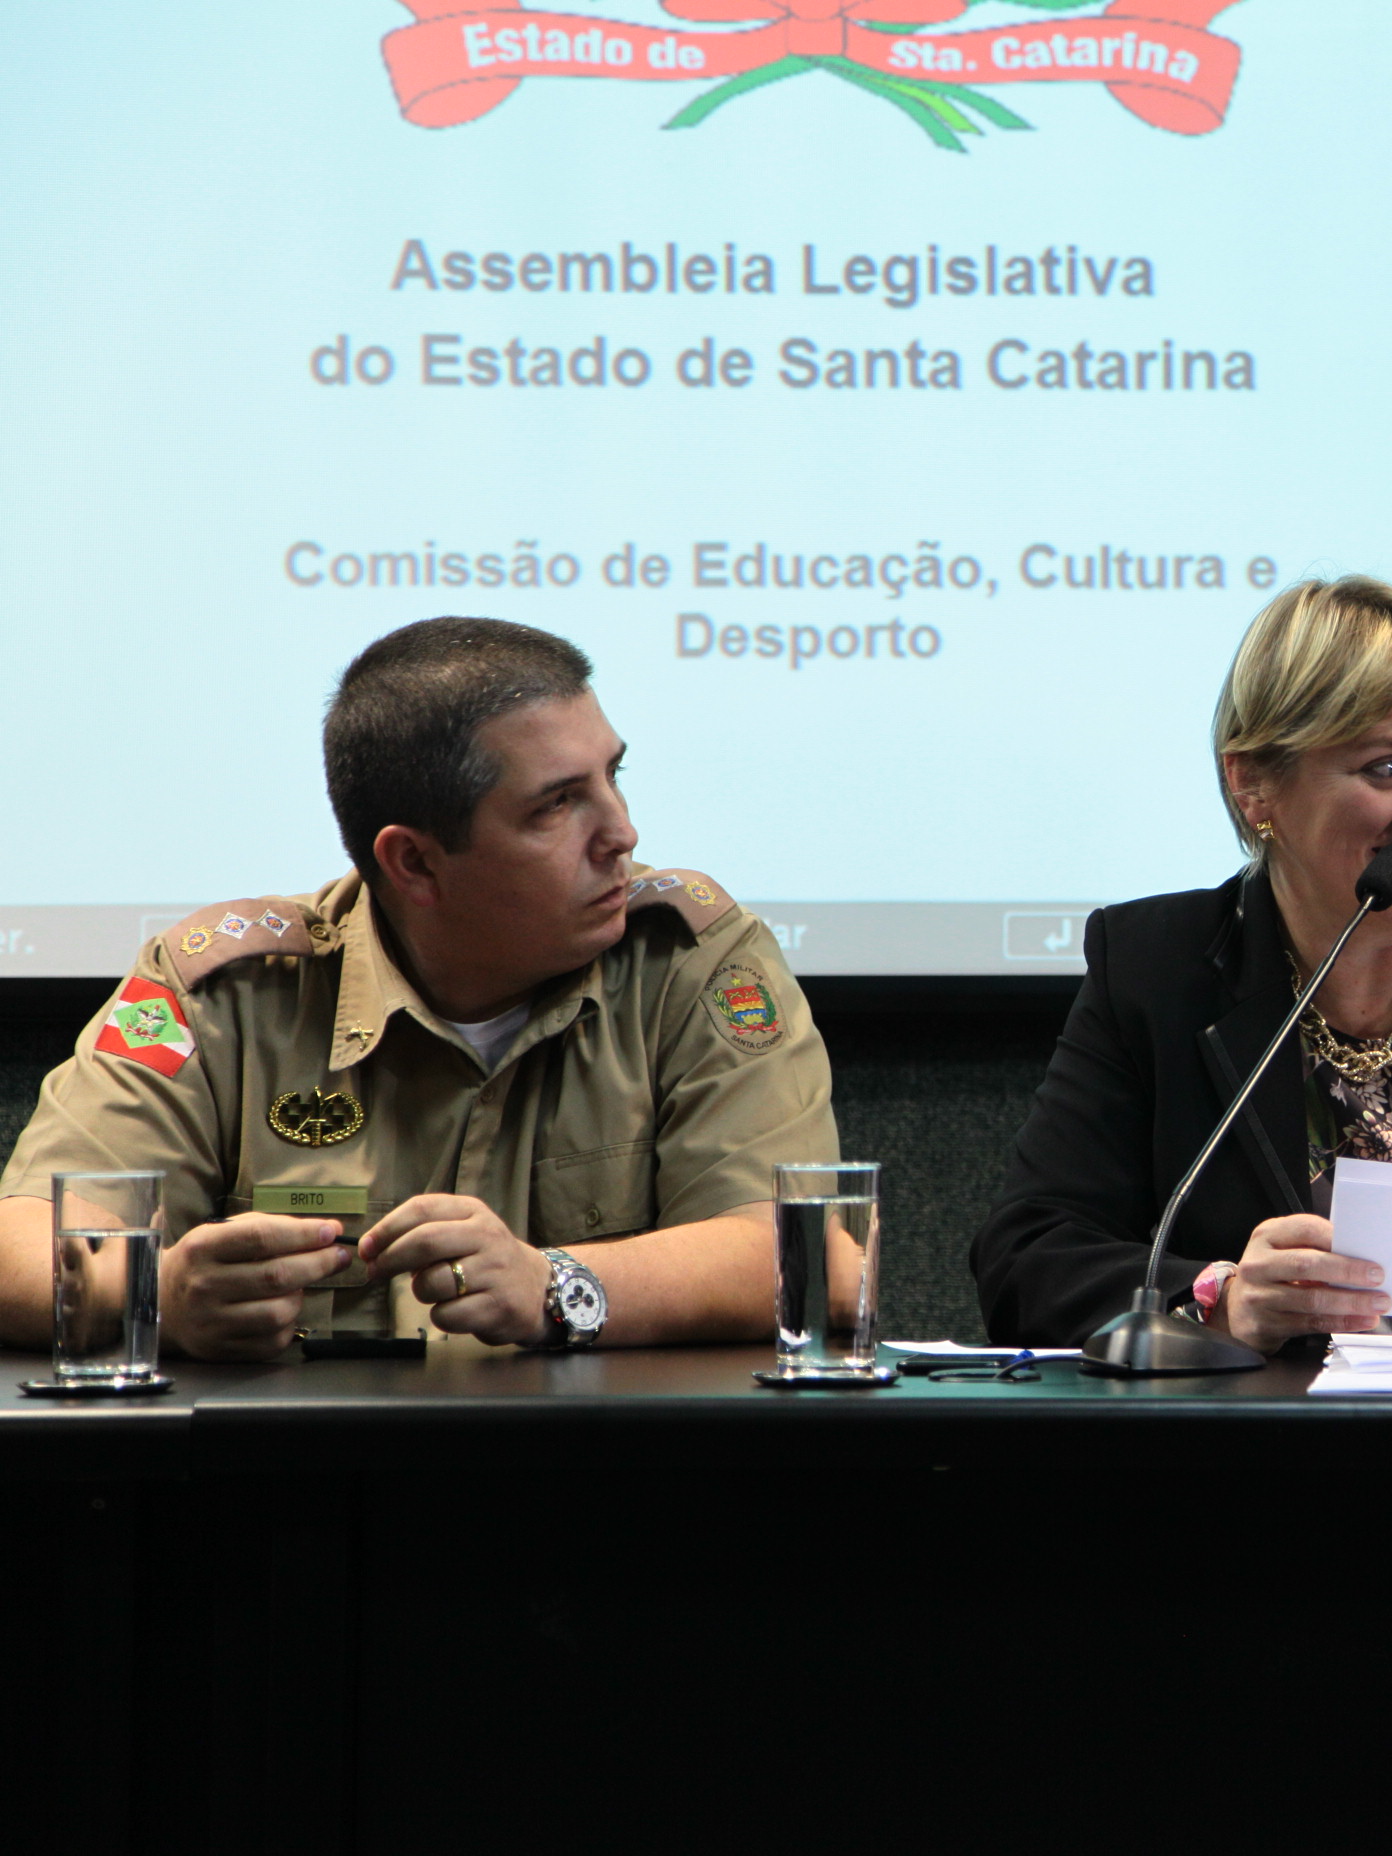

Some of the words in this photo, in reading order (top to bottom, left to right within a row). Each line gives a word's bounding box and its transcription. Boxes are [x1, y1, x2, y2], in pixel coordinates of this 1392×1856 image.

[462, 22, 633, 69] Estado
[648, 35, 706, 70] de
[887, 39, 977, 72] Sta.
[991, 32, 1199, 83] Catarina
[391, 238, 778, 295] Assembleia
[802, 242, 1157, 310] Legislativa
[310, 333, 397, 387] do
[420, 333, 654, 389] Estado
[676, 335, 756, 390] de
[778, 336, 964, 391] Santa
[985, 336, 1258, 392] Catarina
[284, 538, 582, 589] Comissão
[601, 540, 672, 588] de
[692, 540, 1000, 600] Educação,
[1018, 542, 1227, 591] Cultura
[1246, 553, 1279, 591] e
[675, 610, 943, 671] Desporto
[729, 963, 765, 982] MILITAR
[731, 1034, 756, 1049] SANTA
[290, 1193, 324, 1206] BRITO
